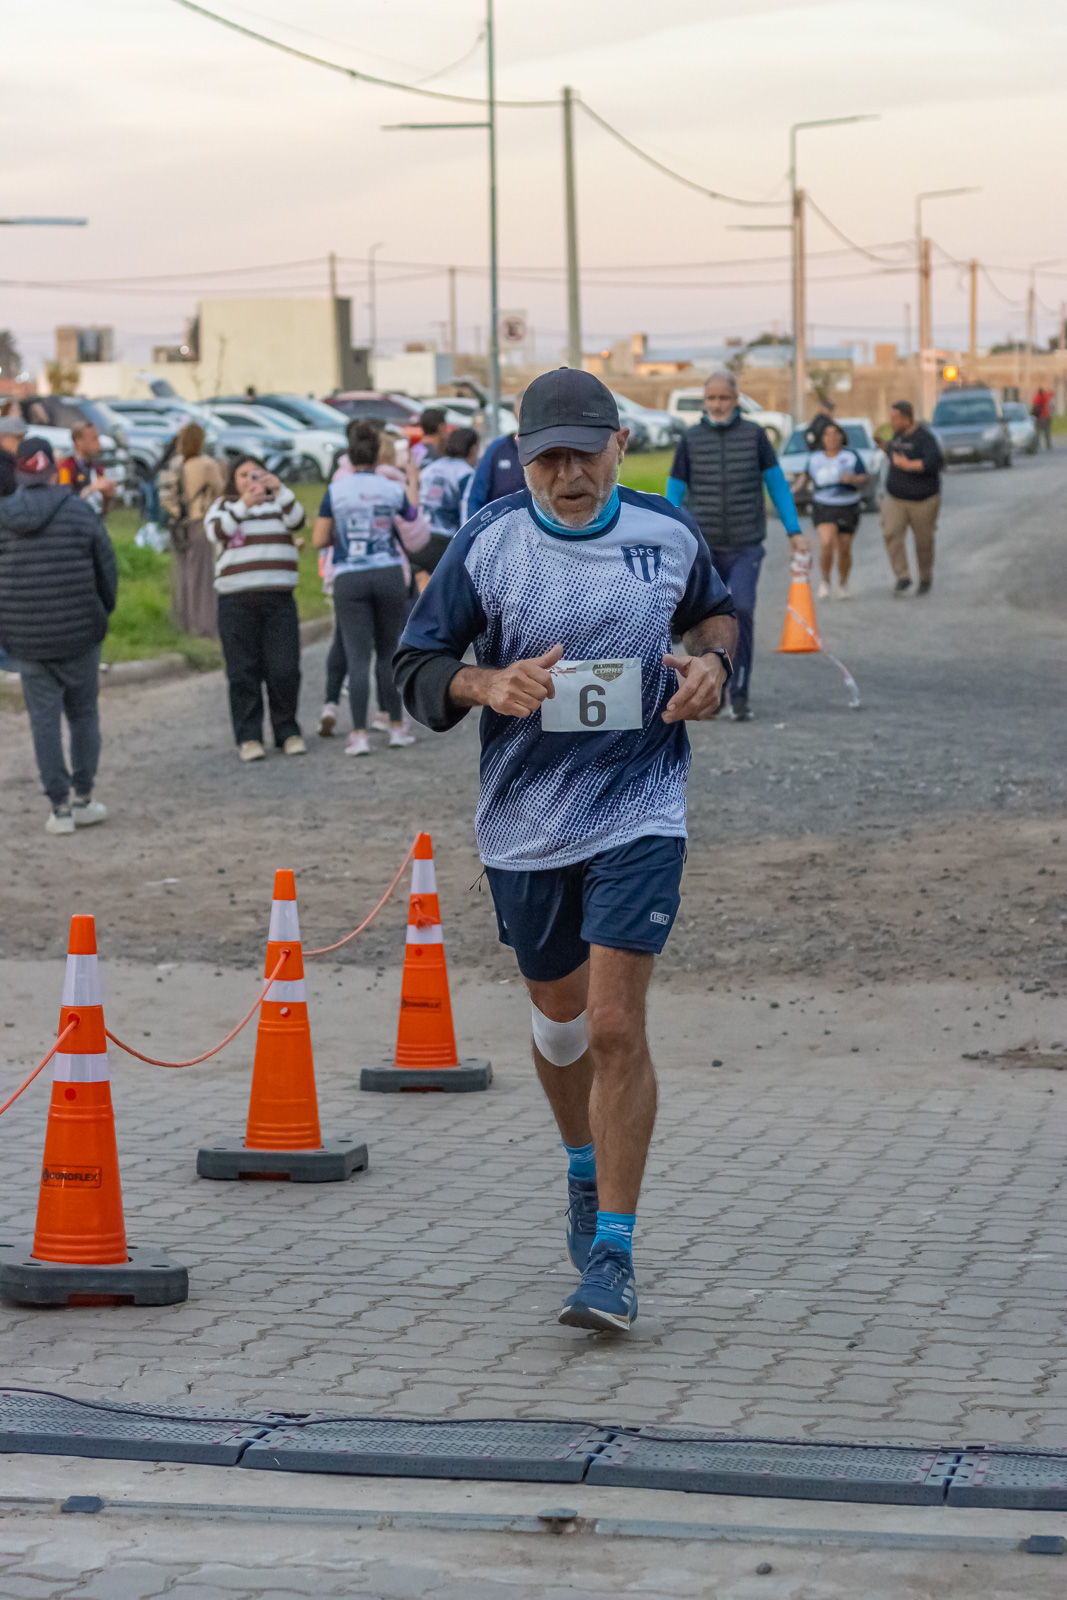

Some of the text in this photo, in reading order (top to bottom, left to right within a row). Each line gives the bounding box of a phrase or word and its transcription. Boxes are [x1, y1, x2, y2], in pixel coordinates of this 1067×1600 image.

[629, 548, 654, 556] SFC
[579, 684, 606, 727] 6
[49, 1172, 98, 1181] CONOFLEX
